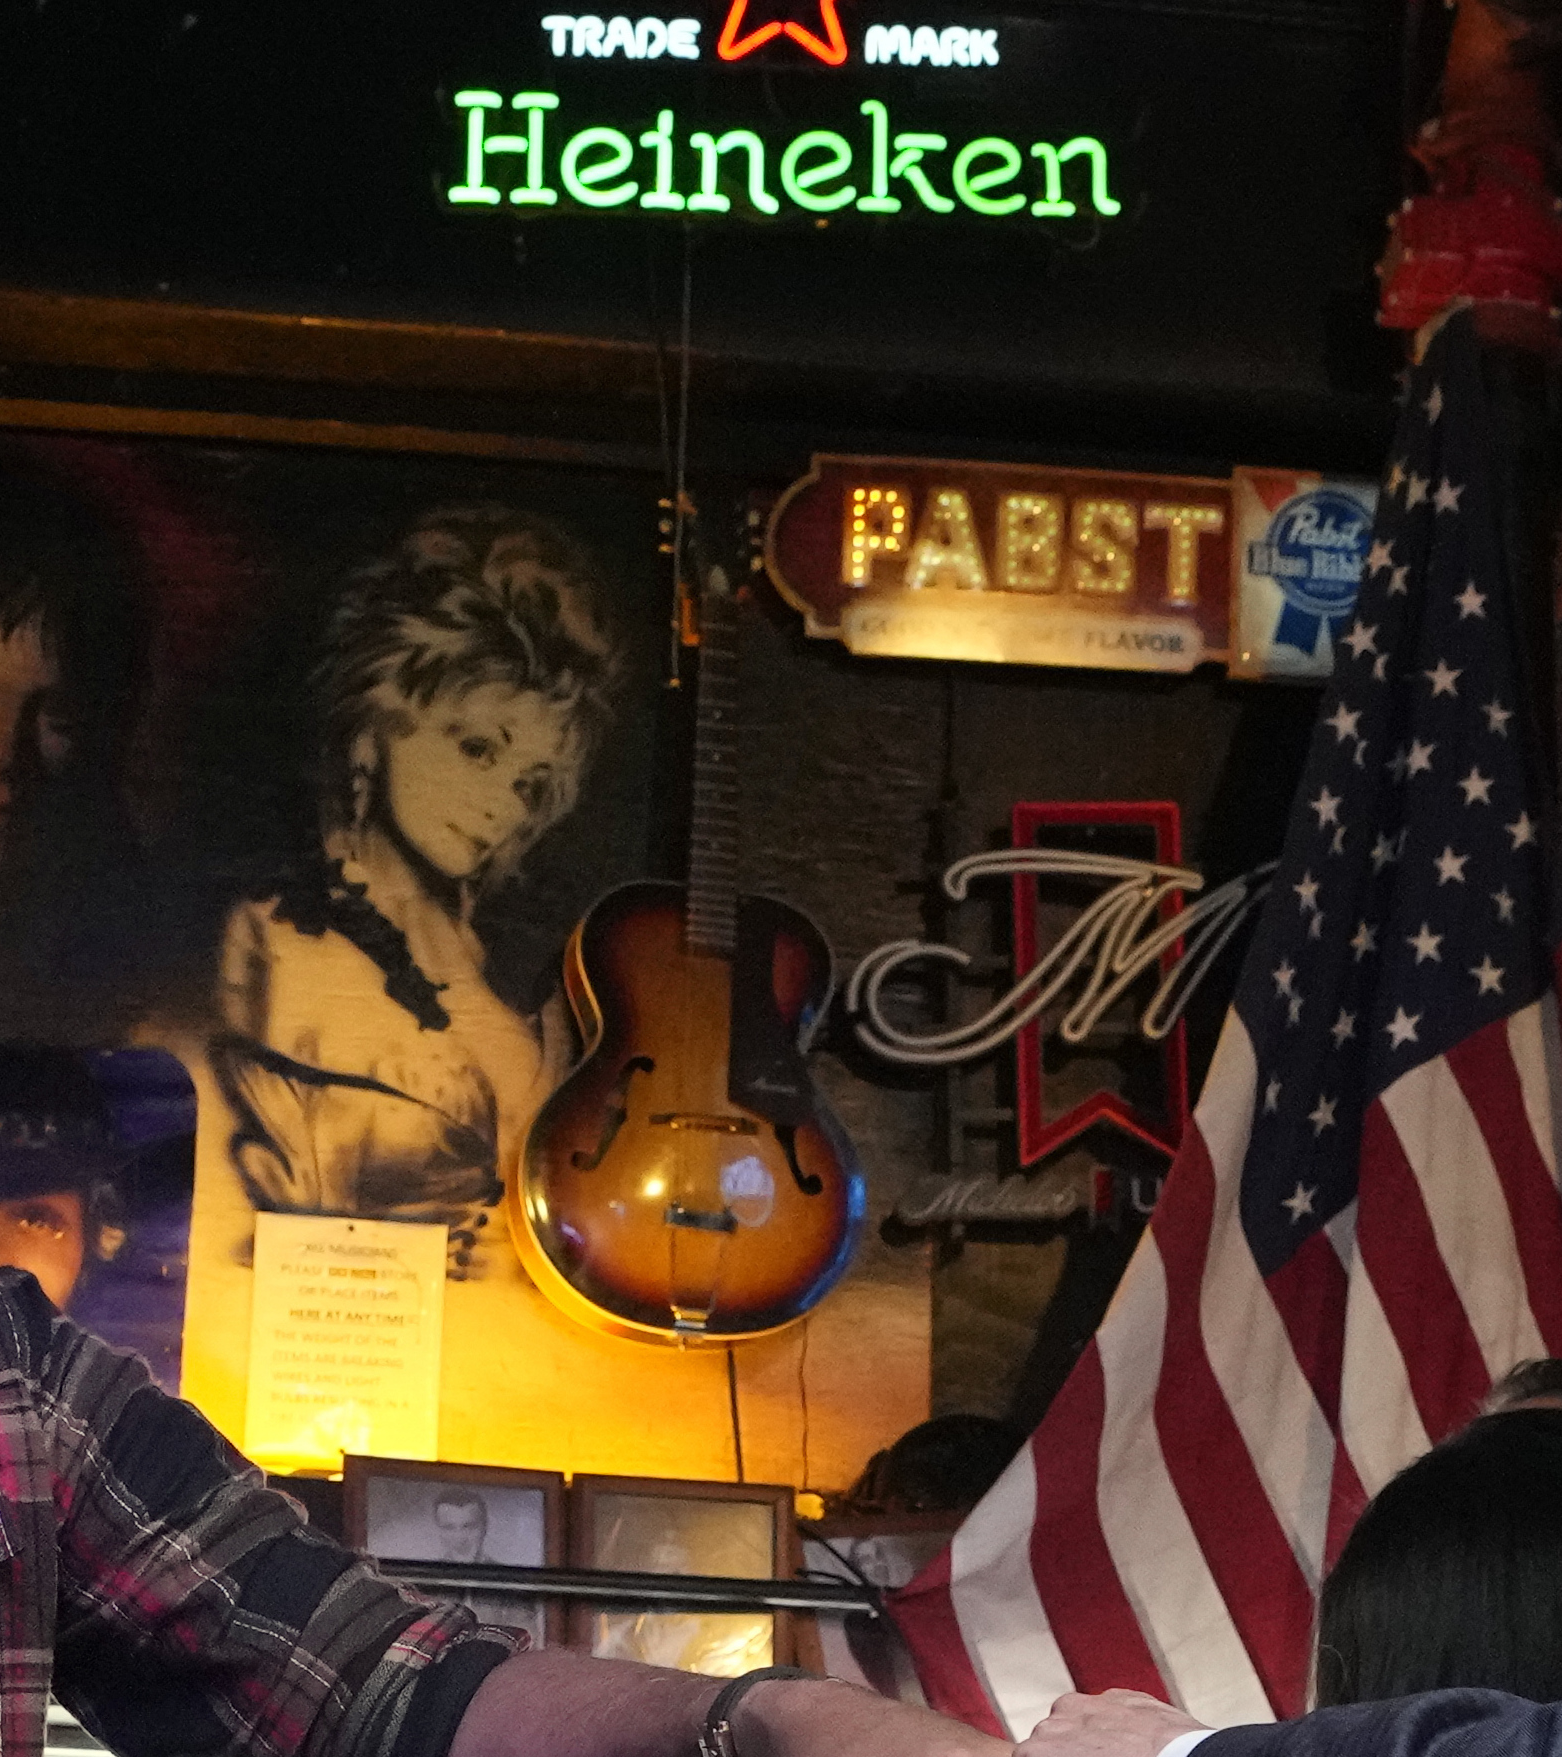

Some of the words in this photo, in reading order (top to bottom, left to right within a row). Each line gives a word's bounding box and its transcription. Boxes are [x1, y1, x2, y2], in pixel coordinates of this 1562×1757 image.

[541, 15, 701, 60] TRADE
[864, 24, 1000, 67] MARK
[448, 90, 1121, 217] Heineken
[842, 486, 1223, 607] PABST
[1082, 627, 1186, 654] FLAVOR
